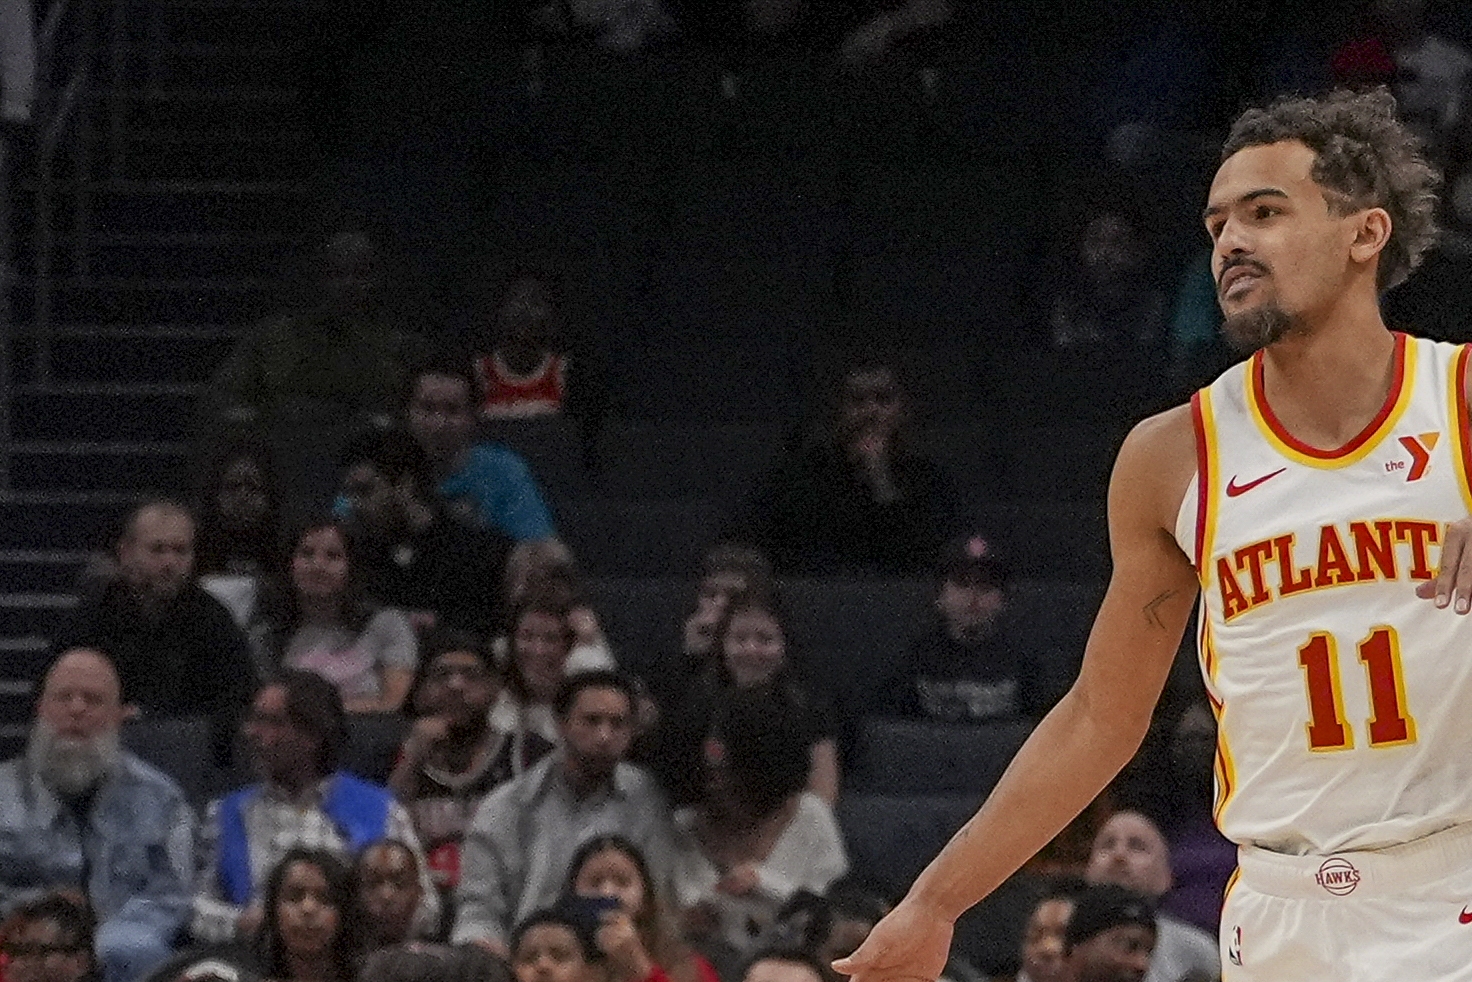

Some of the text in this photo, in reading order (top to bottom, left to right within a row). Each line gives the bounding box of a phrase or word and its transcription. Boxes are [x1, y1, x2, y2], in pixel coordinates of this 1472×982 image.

[1385, 460, 1405, 472] the
[1216, 517, 1450, 623] ATLANT
[1297, 625, 1417, 752] 11
[1315, 869, 1361, 885] HAWKS
